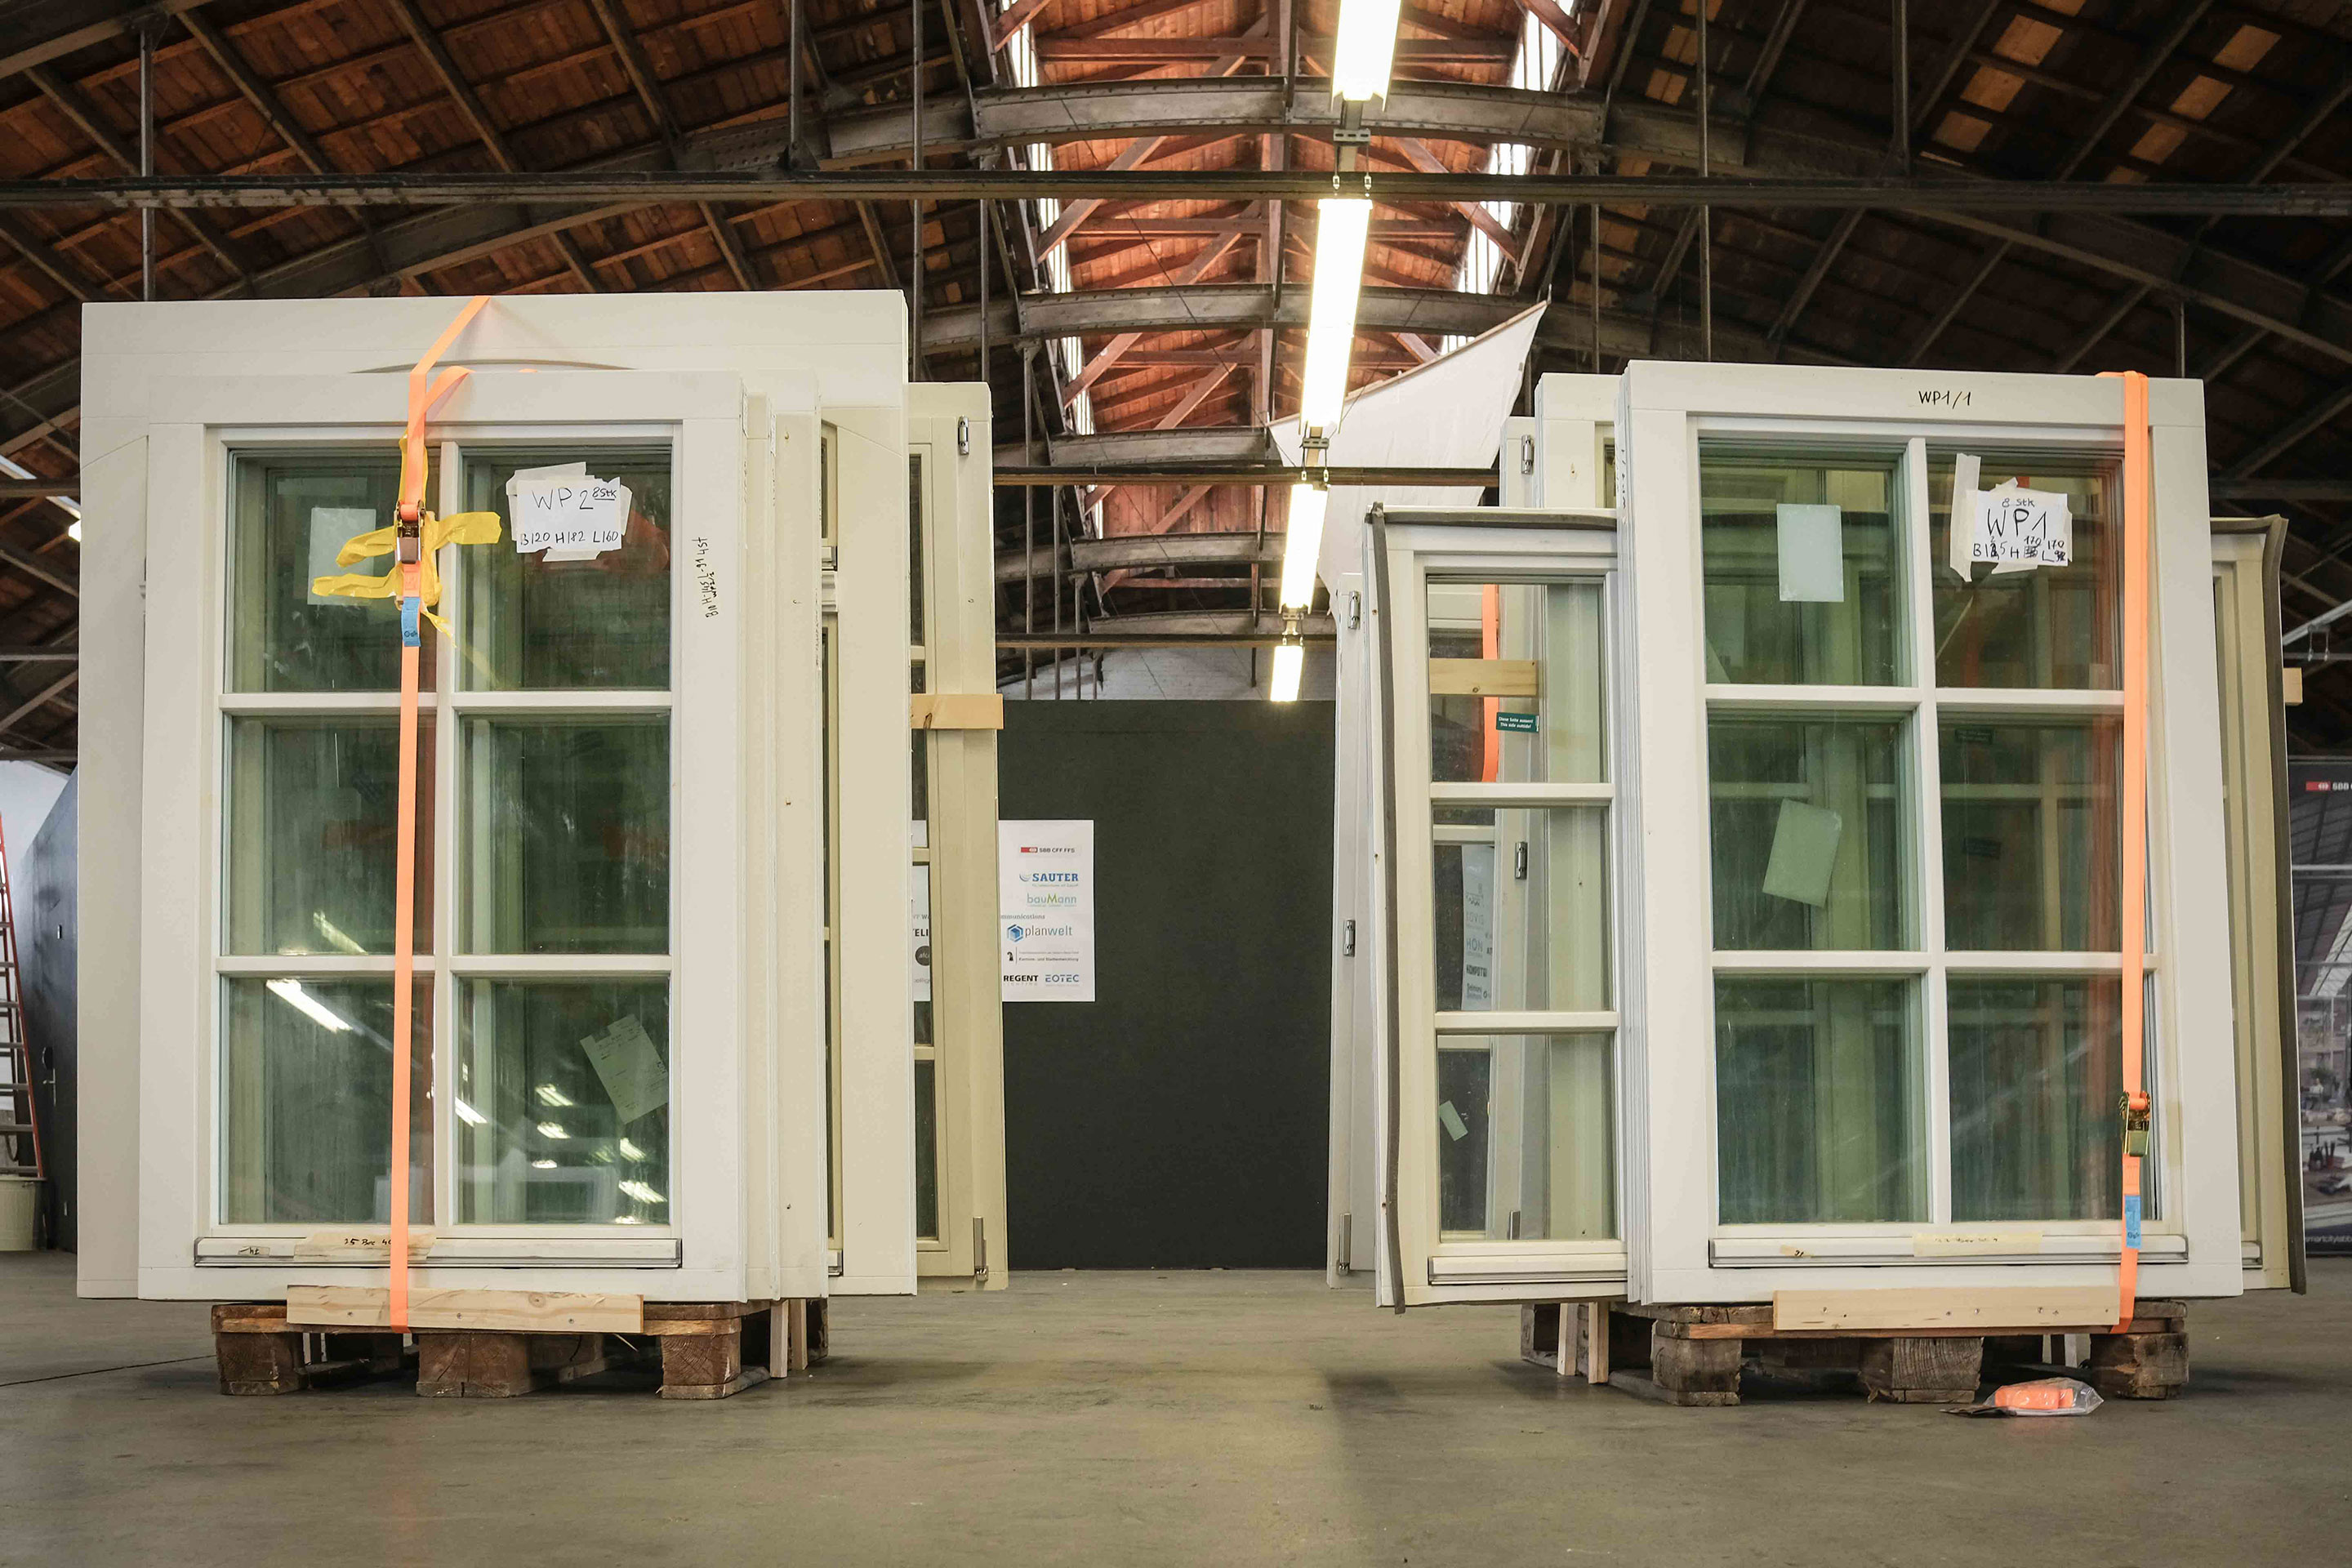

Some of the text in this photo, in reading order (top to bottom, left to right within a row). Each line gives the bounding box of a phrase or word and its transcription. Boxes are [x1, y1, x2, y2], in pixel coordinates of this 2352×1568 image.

[1918, 390, 1971, 409] WP1/1
[2002, 497, 2011, 508] 8
[1031, 873, 1079, 882] SAUTER
[1027, 893, 1077, 904] bauMann
[1025, 924, 1073, 938] planwelt
[1003, 974, 1039, 982] REGENT
